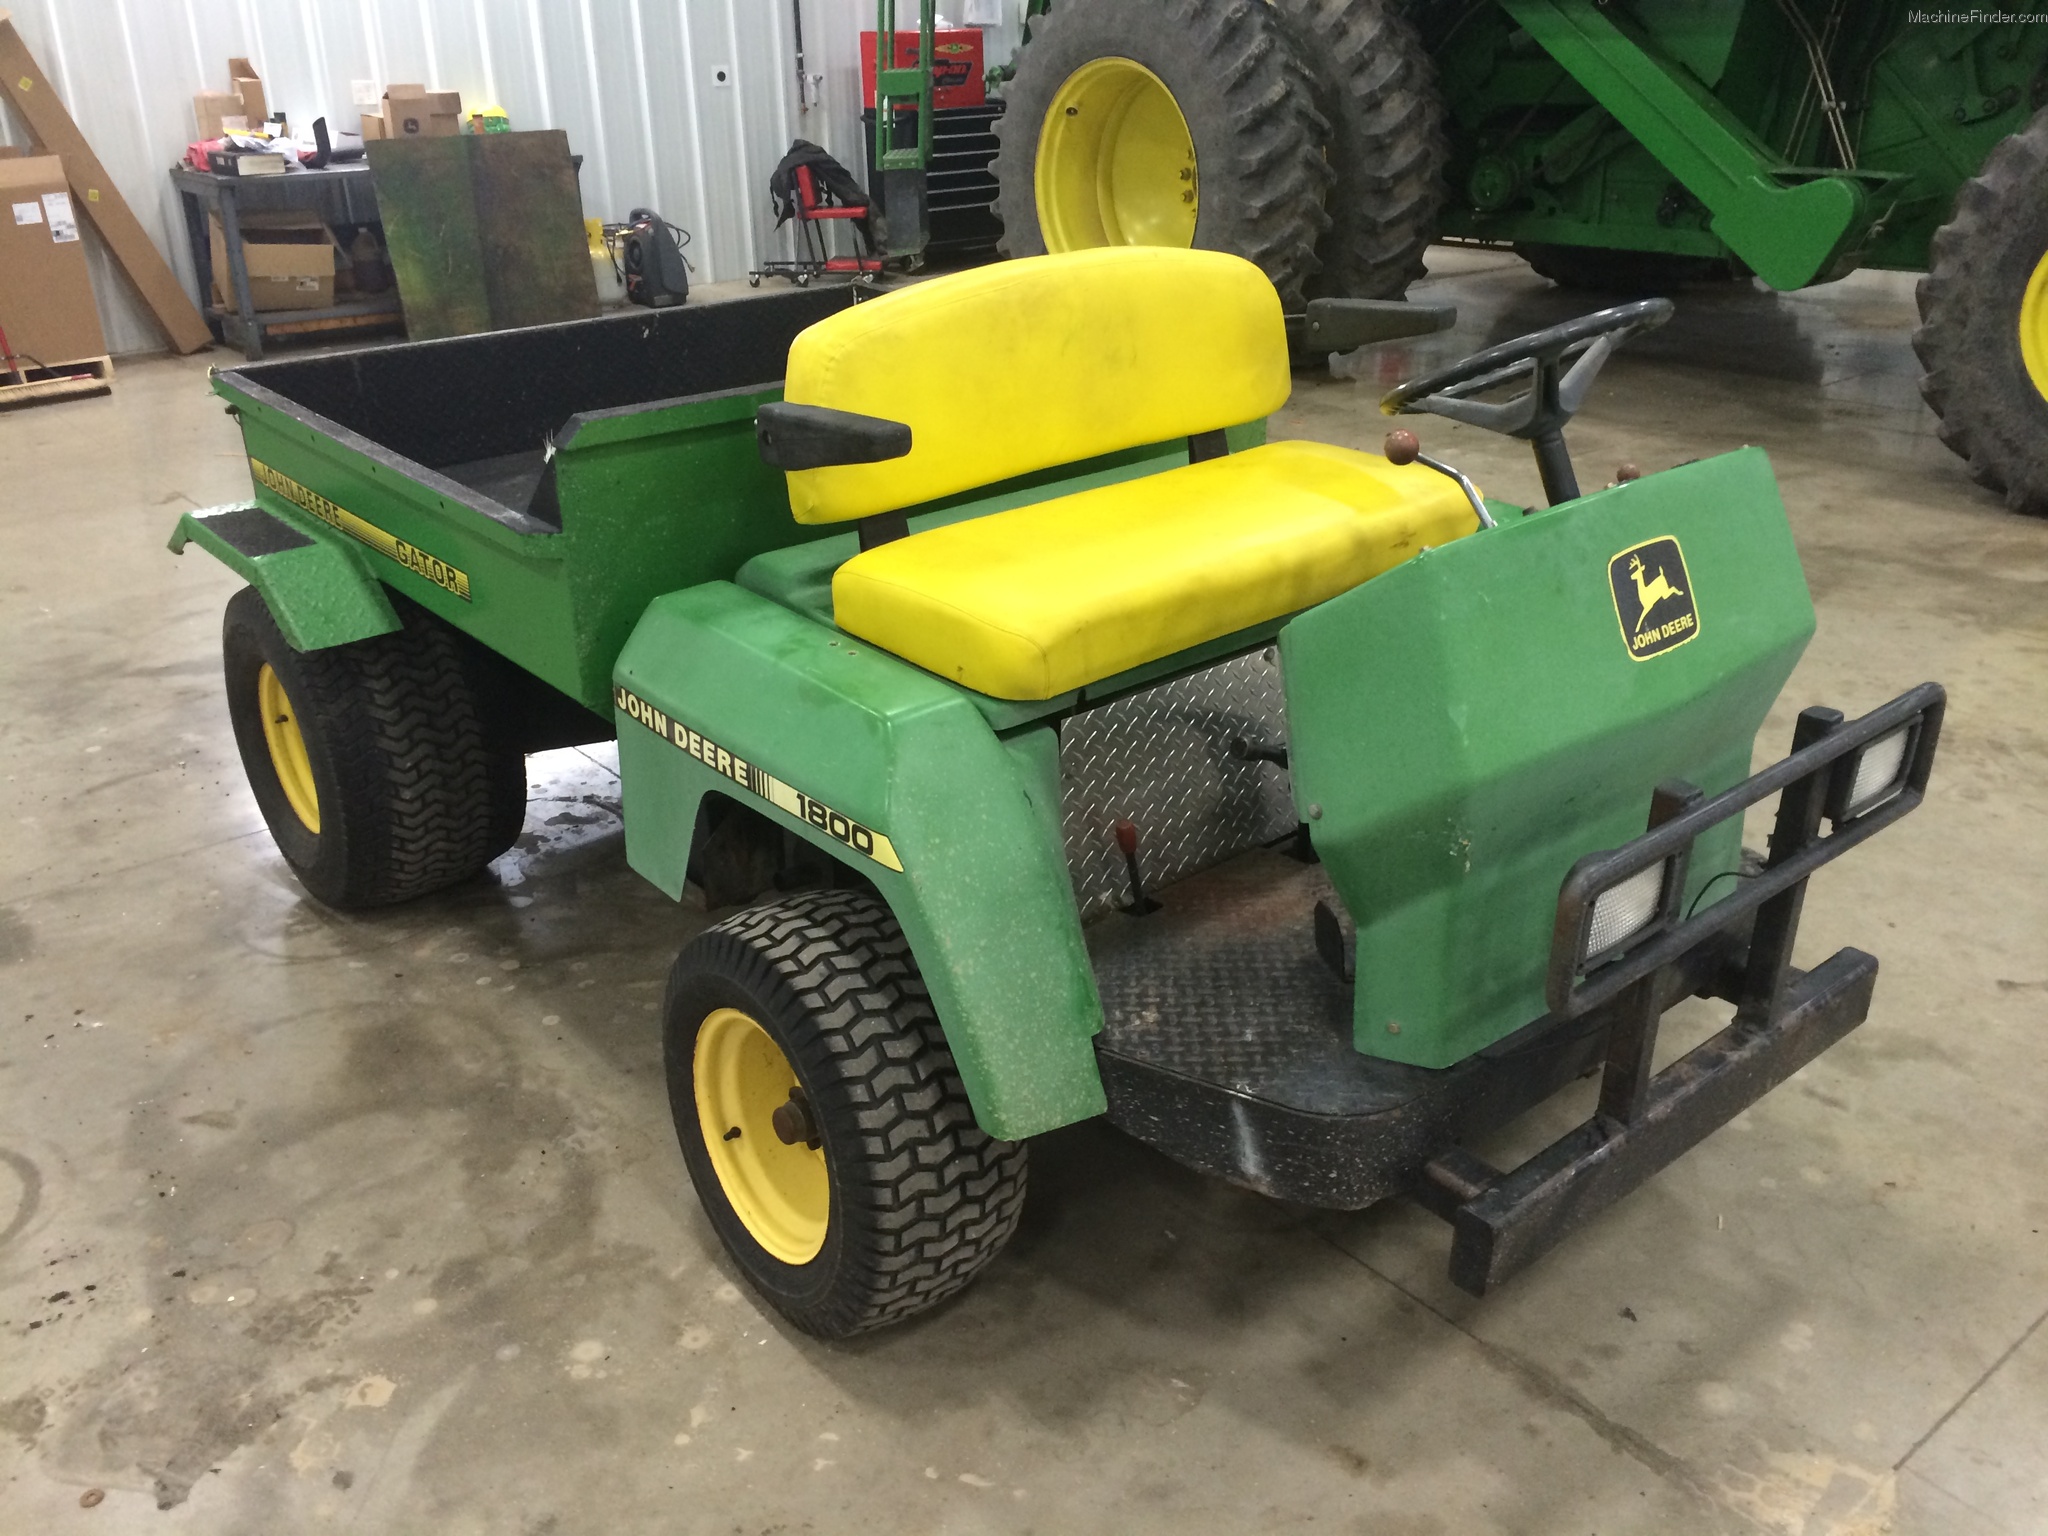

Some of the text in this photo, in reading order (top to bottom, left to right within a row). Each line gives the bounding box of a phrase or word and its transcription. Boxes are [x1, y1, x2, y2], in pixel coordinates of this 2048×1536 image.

[262, 466, 344, 530] JOHN DEERE
[395, 539, 459, 594] GATOR
[1632, 613, 1694, 651] JOHN DEERE
[617, 687, 874, 856] JOHN DEERE 1800
